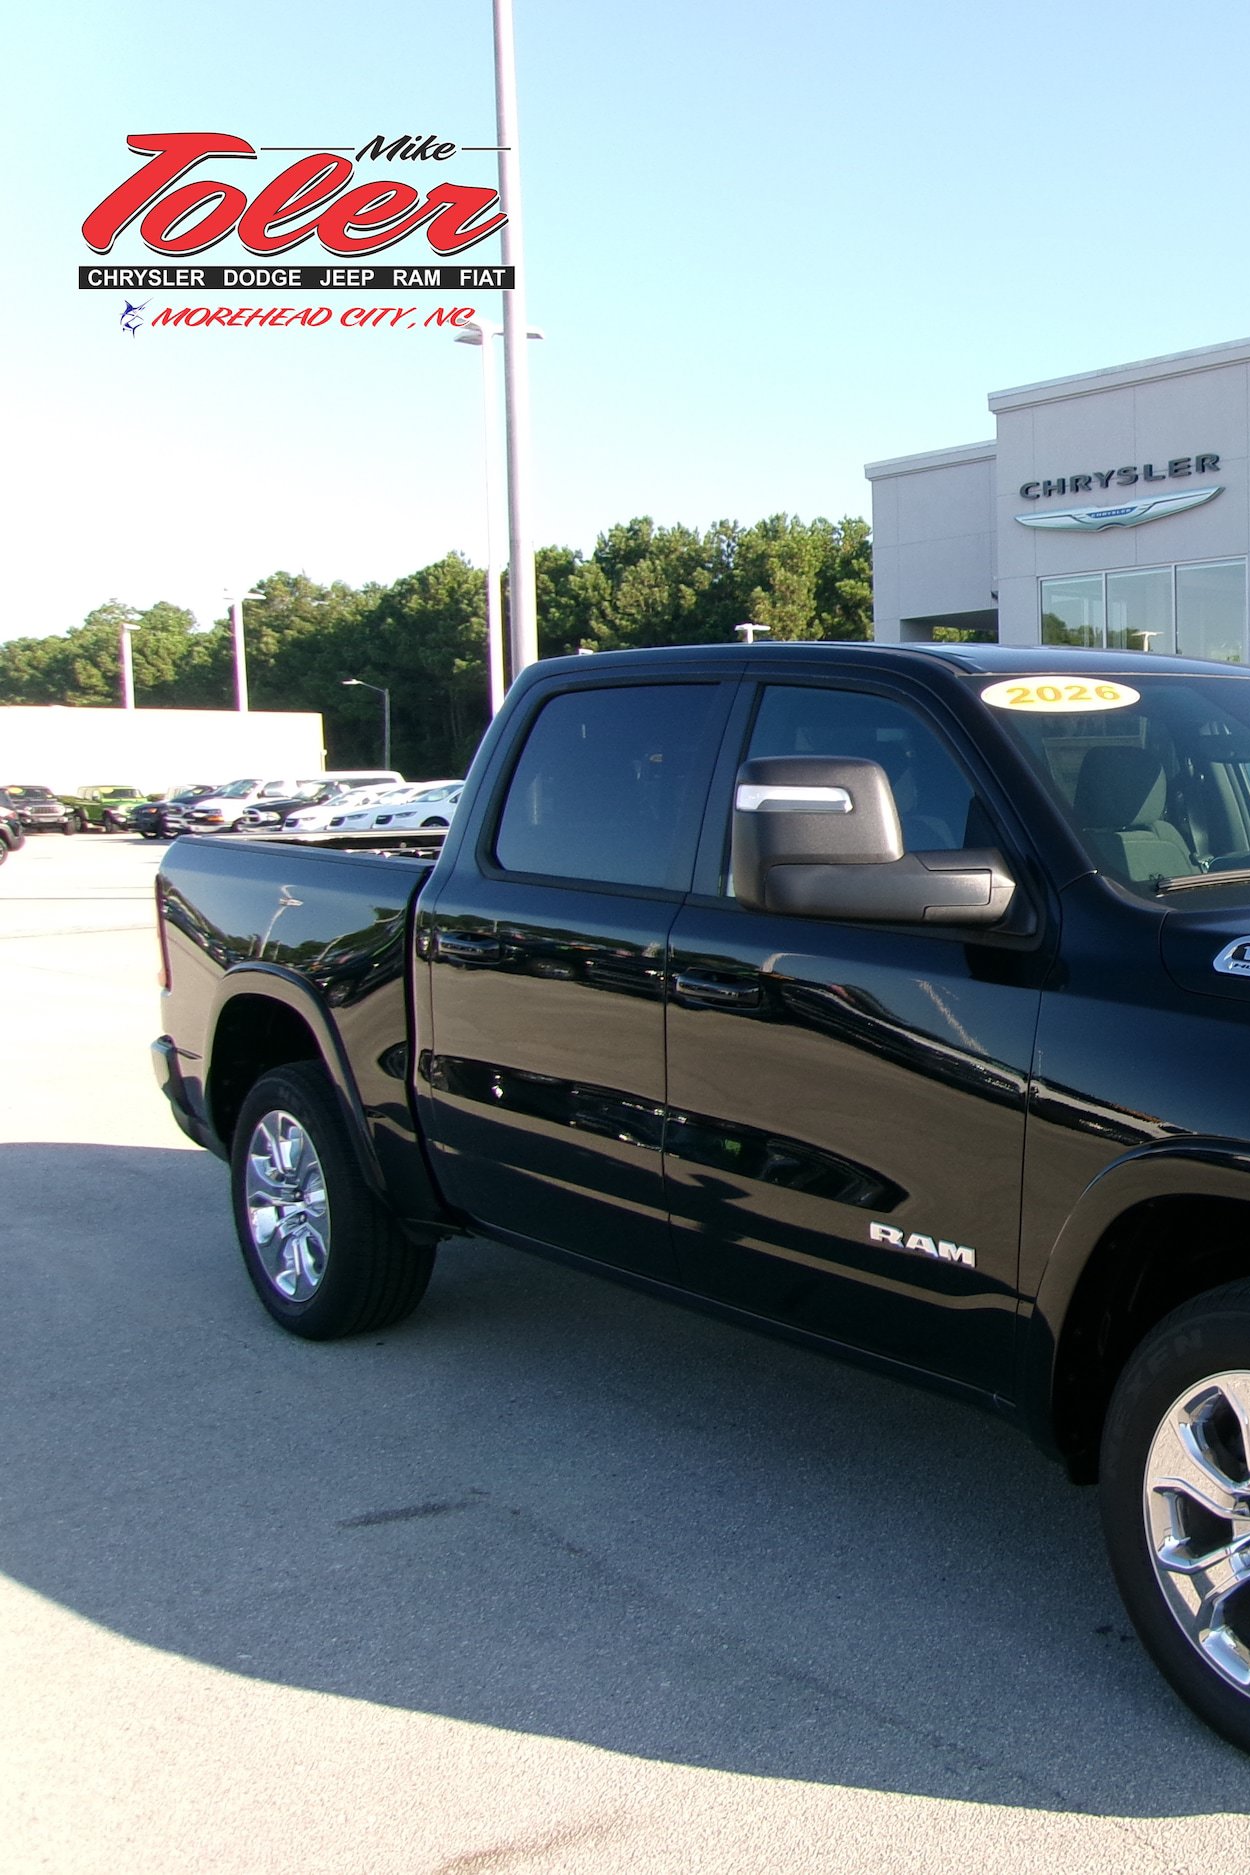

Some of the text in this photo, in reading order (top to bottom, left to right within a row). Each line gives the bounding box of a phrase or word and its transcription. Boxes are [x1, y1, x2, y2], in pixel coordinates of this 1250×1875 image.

[1019, 452, 1222, 500] CHRYSLER
[1006, 685, 1121, 705] 2026
[869, 1220, 977, 1269] RAM
